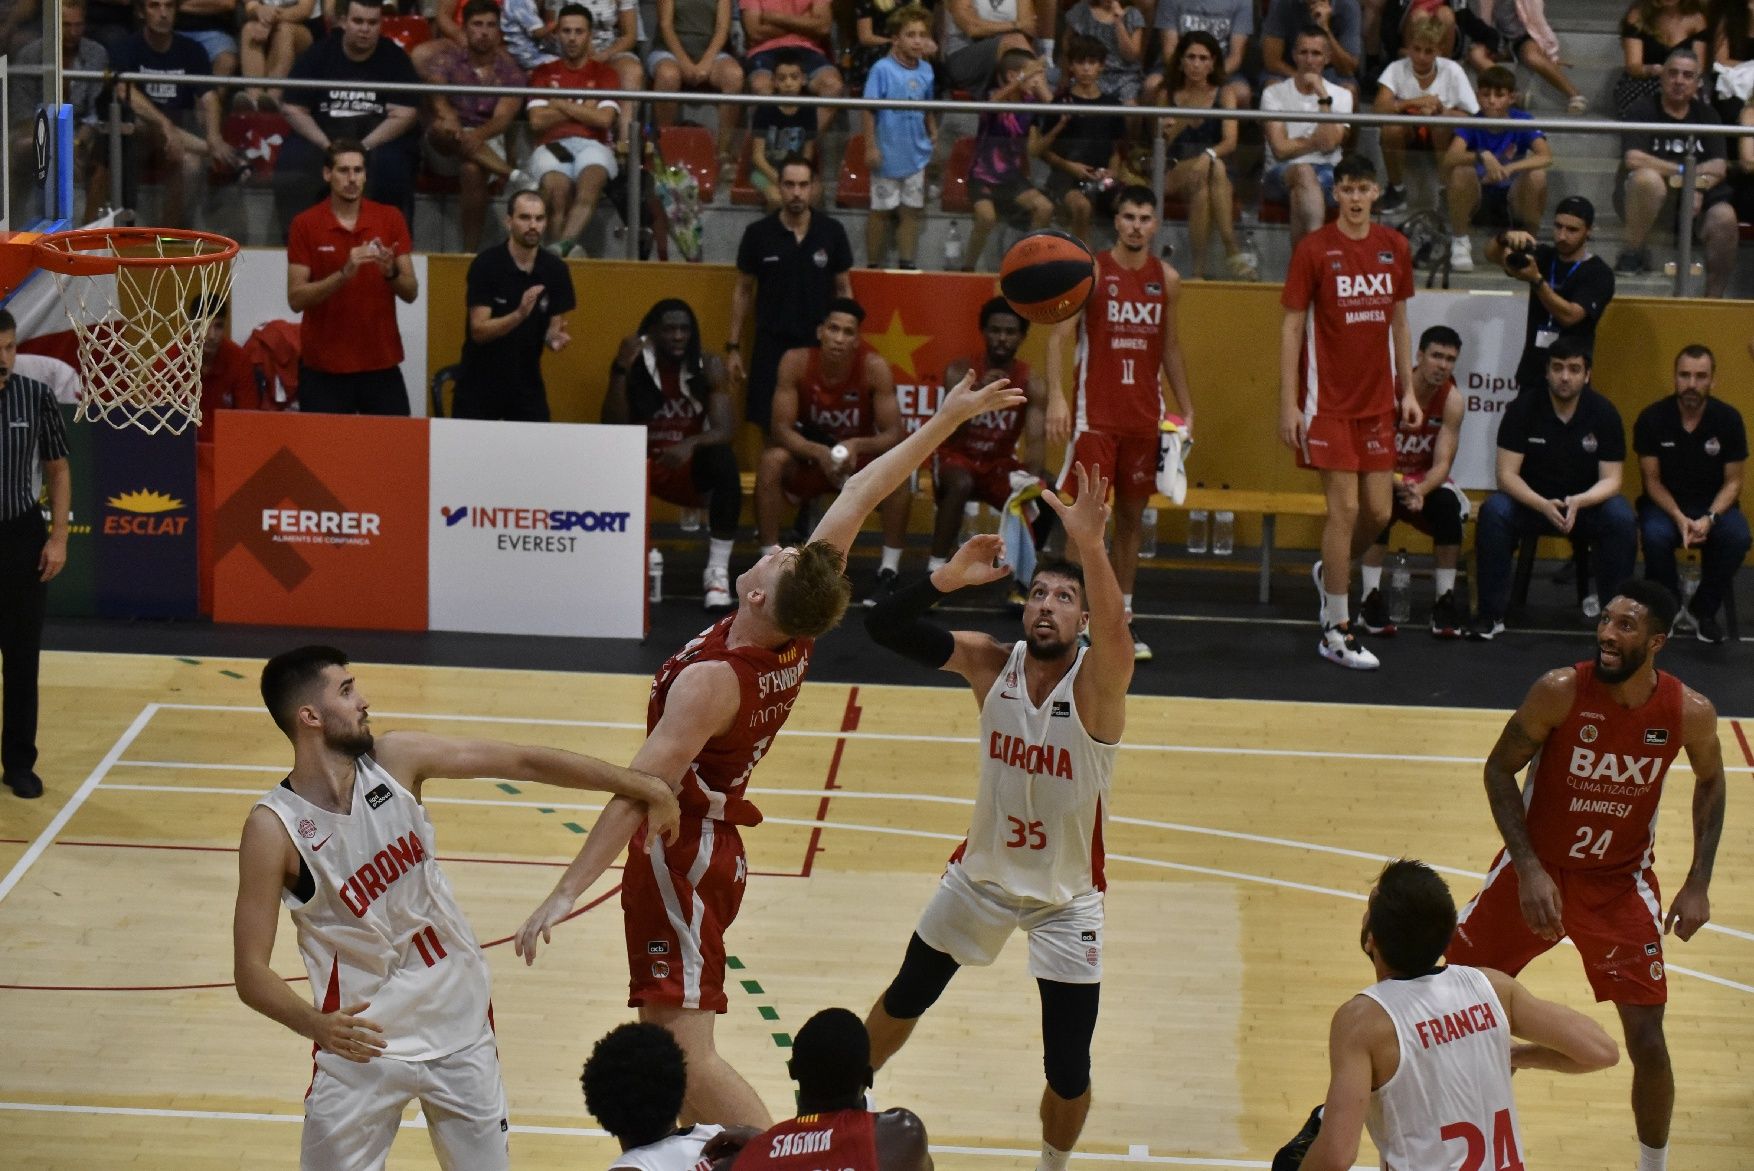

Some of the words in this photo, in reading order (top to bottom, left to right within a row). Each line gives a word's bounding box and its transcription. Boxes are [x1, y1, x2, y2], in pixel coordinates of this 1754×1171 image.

[1335, 273, 1393, 297] BAXI
[1107, 300, 1162, 325] BAXI
[1121, 359, 1135, 385] 11
[1467, 395, 1506, 413] Bar
[103, 515, 189, 536] ESCLAT
[261, 508, 381, 536] FERRER
[472, 505, 631, 533] INTERSPORT
[497, 534, 578, 553] EVEREST
[989, 730, 1074, 781] GIRONA
[1569, 745, 1663, 785] BAXI
[1006, 815, 1047, 850] 35
[1568, 826, 1614, 860] 24
[339, 830, 427, 919] GIRONA
[411, 925, 448, 968] 11
[650, 944, 665, 952] acb
[1415, 1002, 1498, 1050] FRANCH
[769, 1128, 834, 1159] SAGNIA
